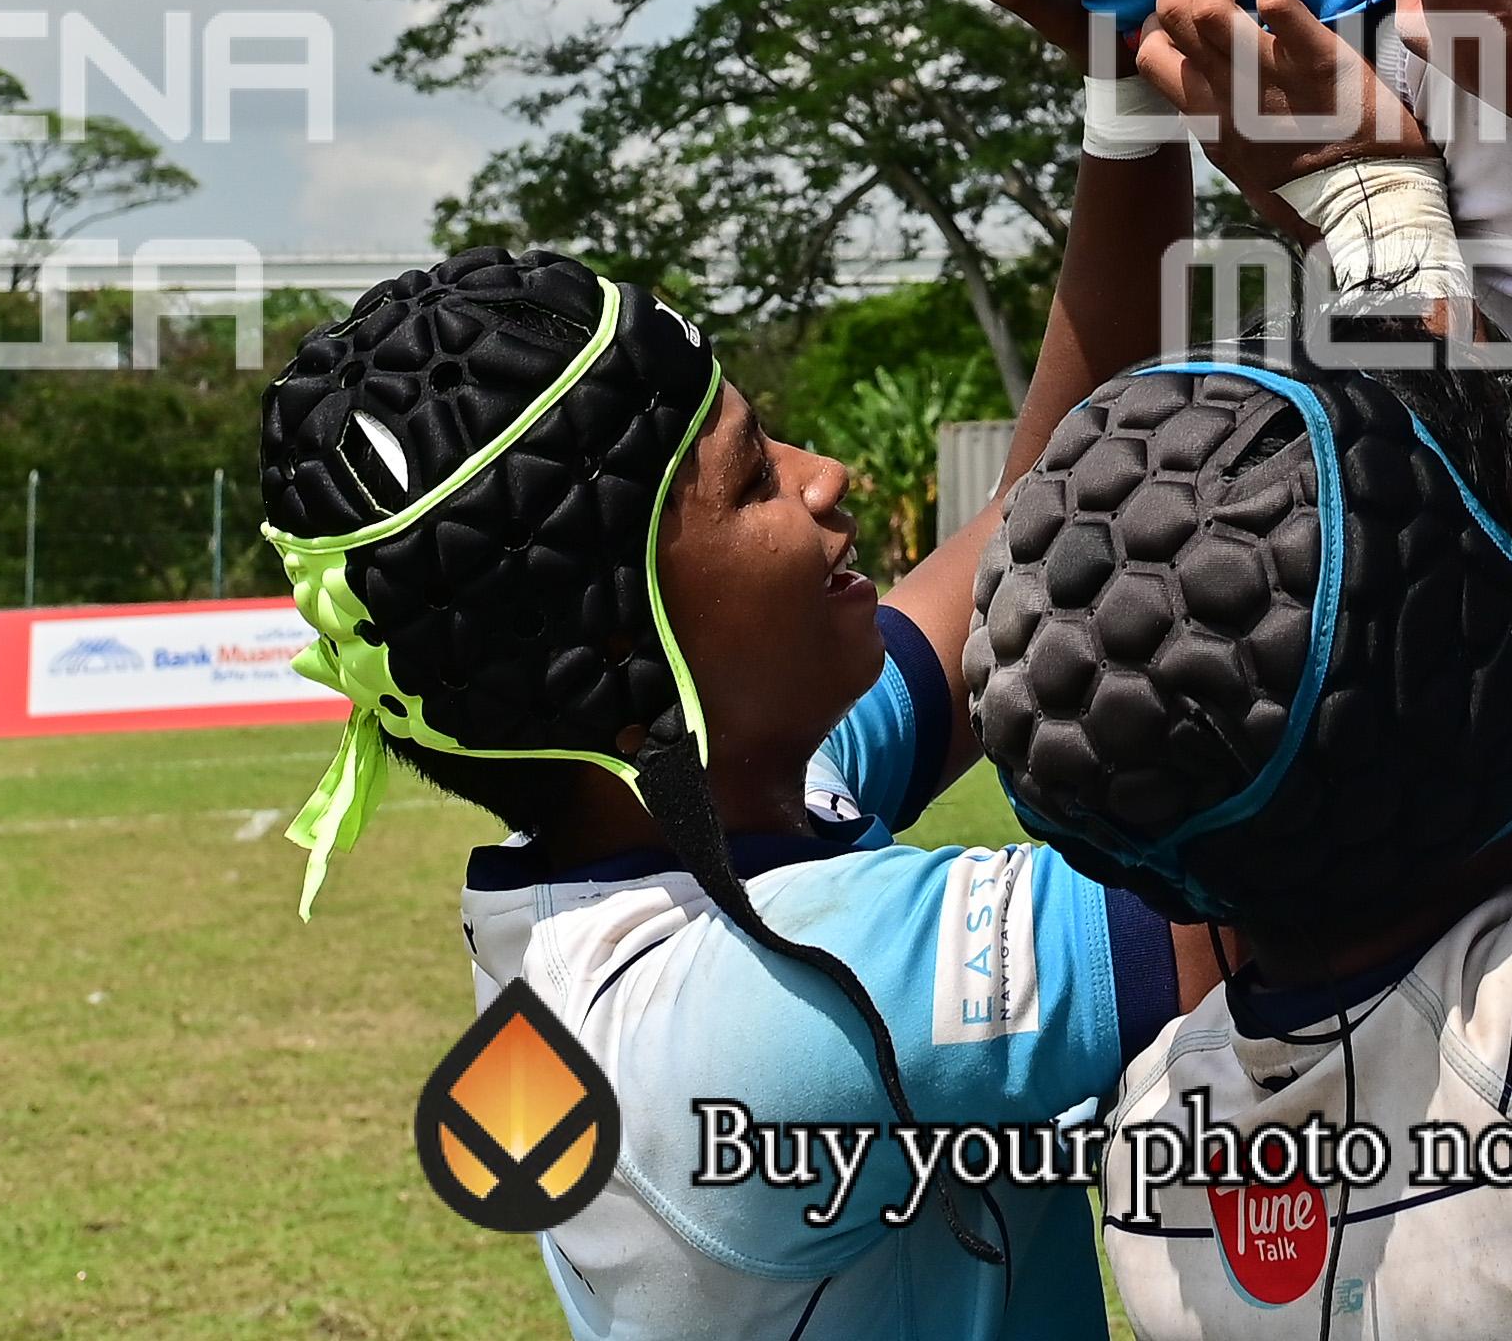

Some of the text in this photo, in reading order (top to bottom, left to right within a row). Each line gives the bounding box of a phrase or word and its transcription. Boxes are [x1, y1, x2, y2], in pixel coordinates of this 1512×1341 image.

[152, 640, 312, 669] Bank Muam
[962, 877, 995, 1026] EAST
[1215, 1181, 1317, 1256] Tune
[1254, 1236, 1298, 1262] Talk
